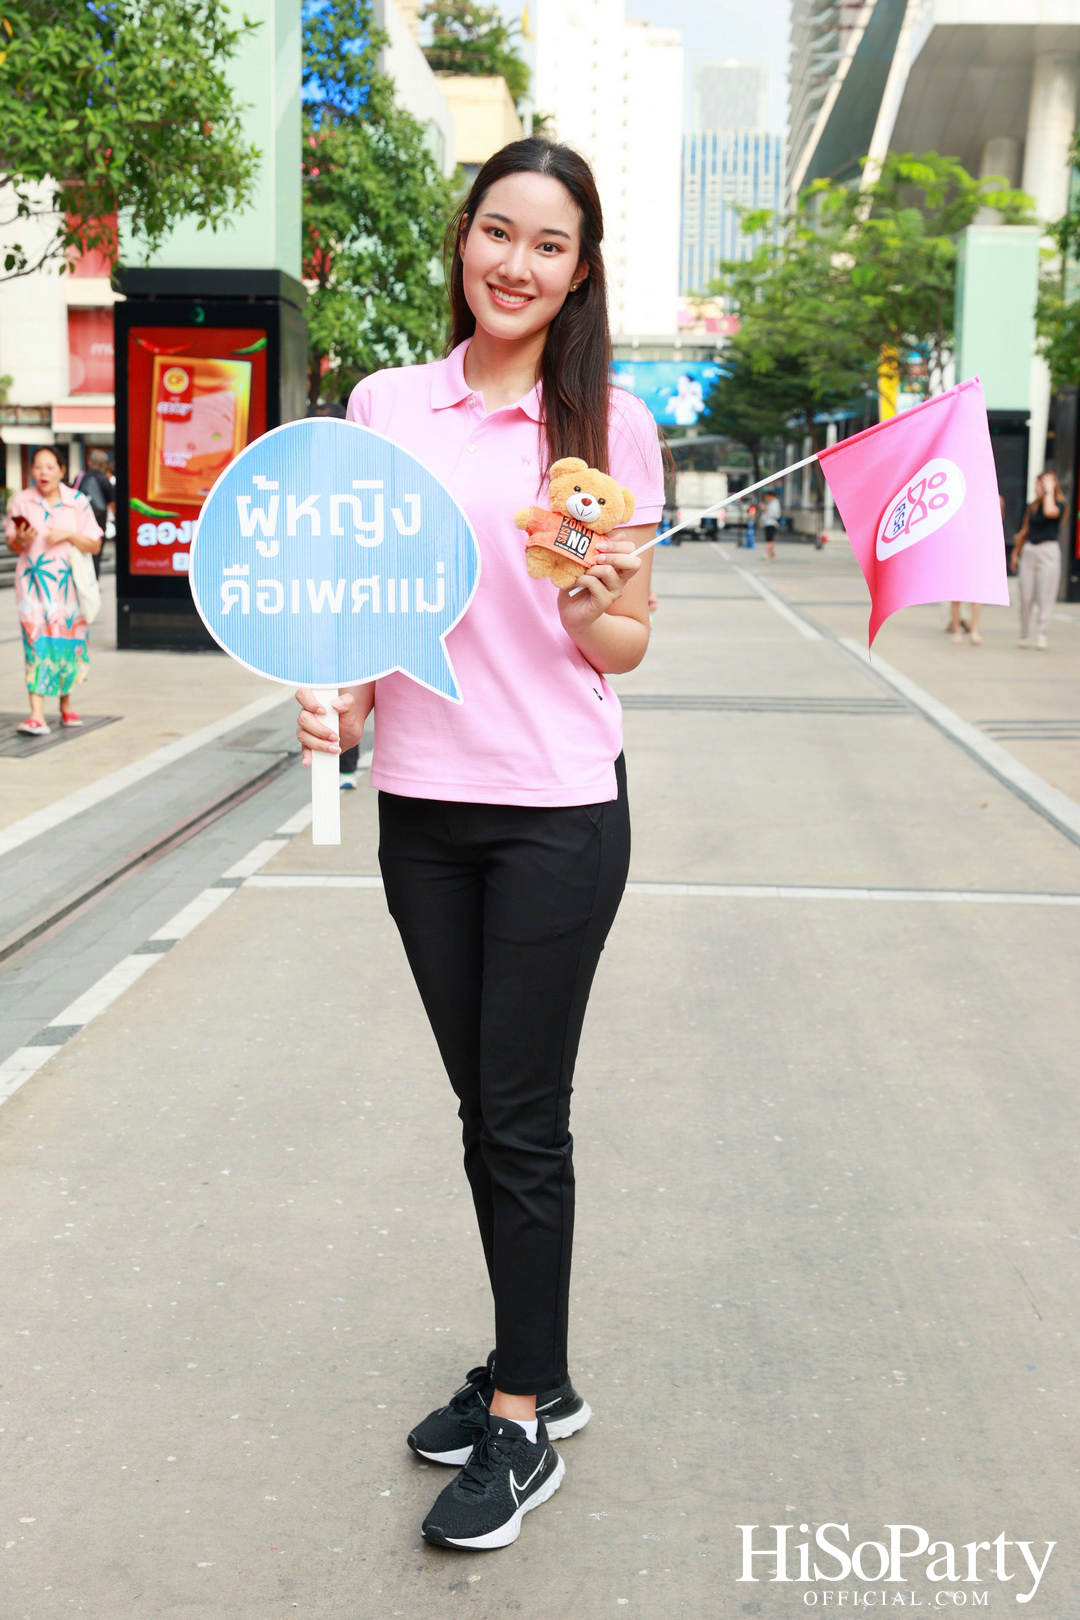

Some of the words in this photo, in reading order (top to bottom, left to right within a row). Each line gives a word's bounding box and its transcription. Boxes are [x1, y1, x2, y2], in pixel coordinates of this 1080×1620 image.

[236, 475, 421, 558] ผู้หญิง
[563, 517, 592, 539] ZONTA
[136, 521, 197, 547] ลอง
[566, 530, 590, 554] NO
[220, 561, 445, 615] คือเพศแม่
